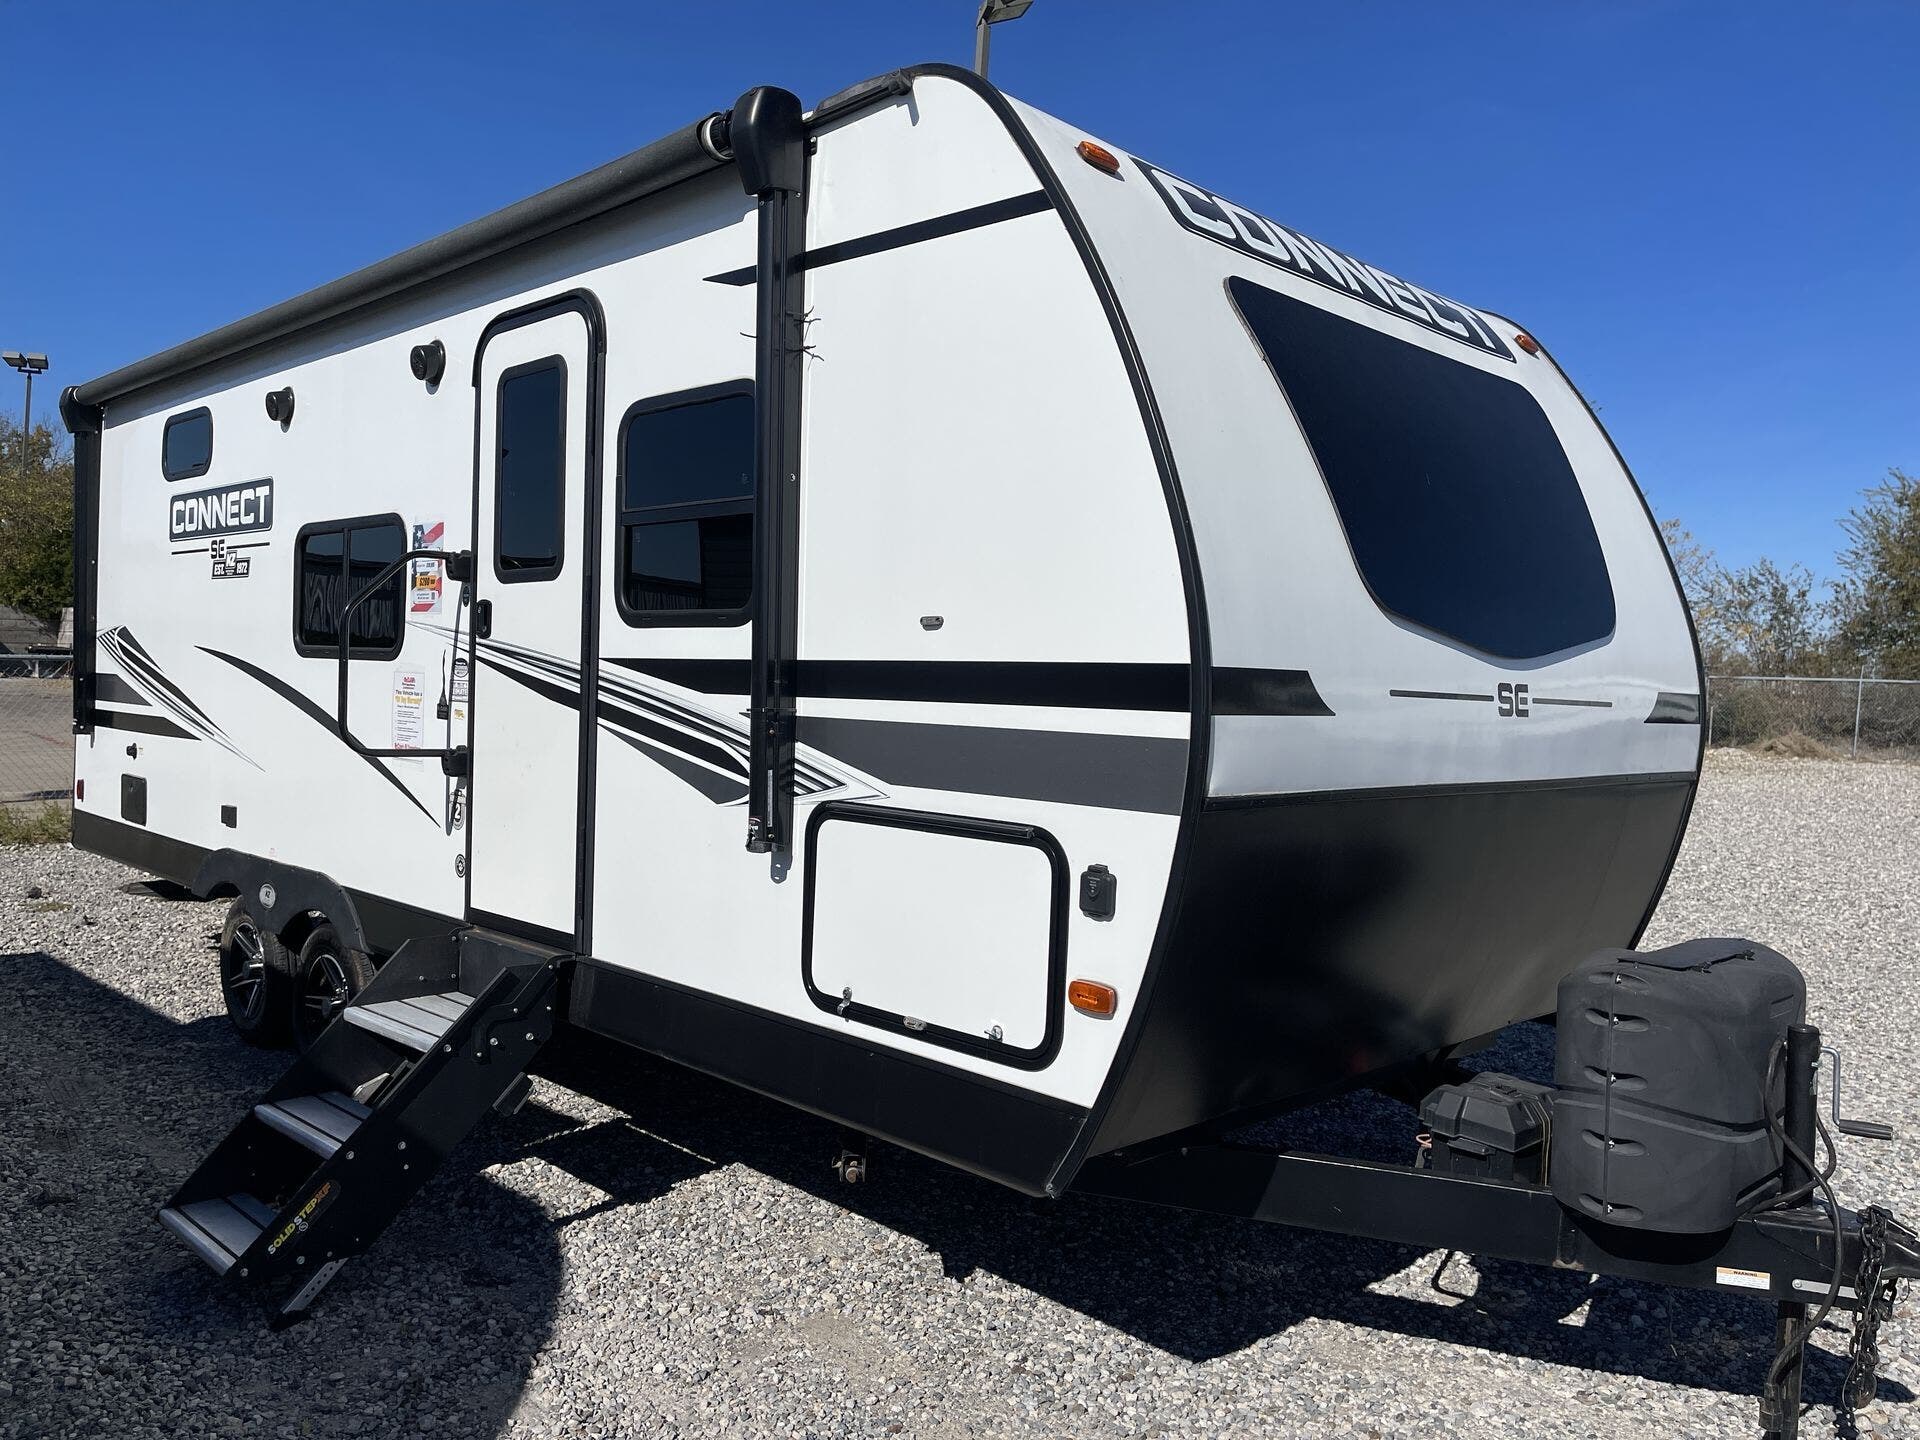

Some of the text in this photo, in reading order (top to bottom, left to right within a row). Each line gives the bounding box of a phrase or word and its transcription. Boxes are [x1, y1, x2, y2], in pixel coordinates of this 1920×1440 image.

[1151, 168, 1496, 350] CONNECT
[172, 485, 270, 534] CONNECT
[211, 539, 225, 559] SE
[236, 562, 248, 574] 1972
[1498, 683, 1529, 718] SE
